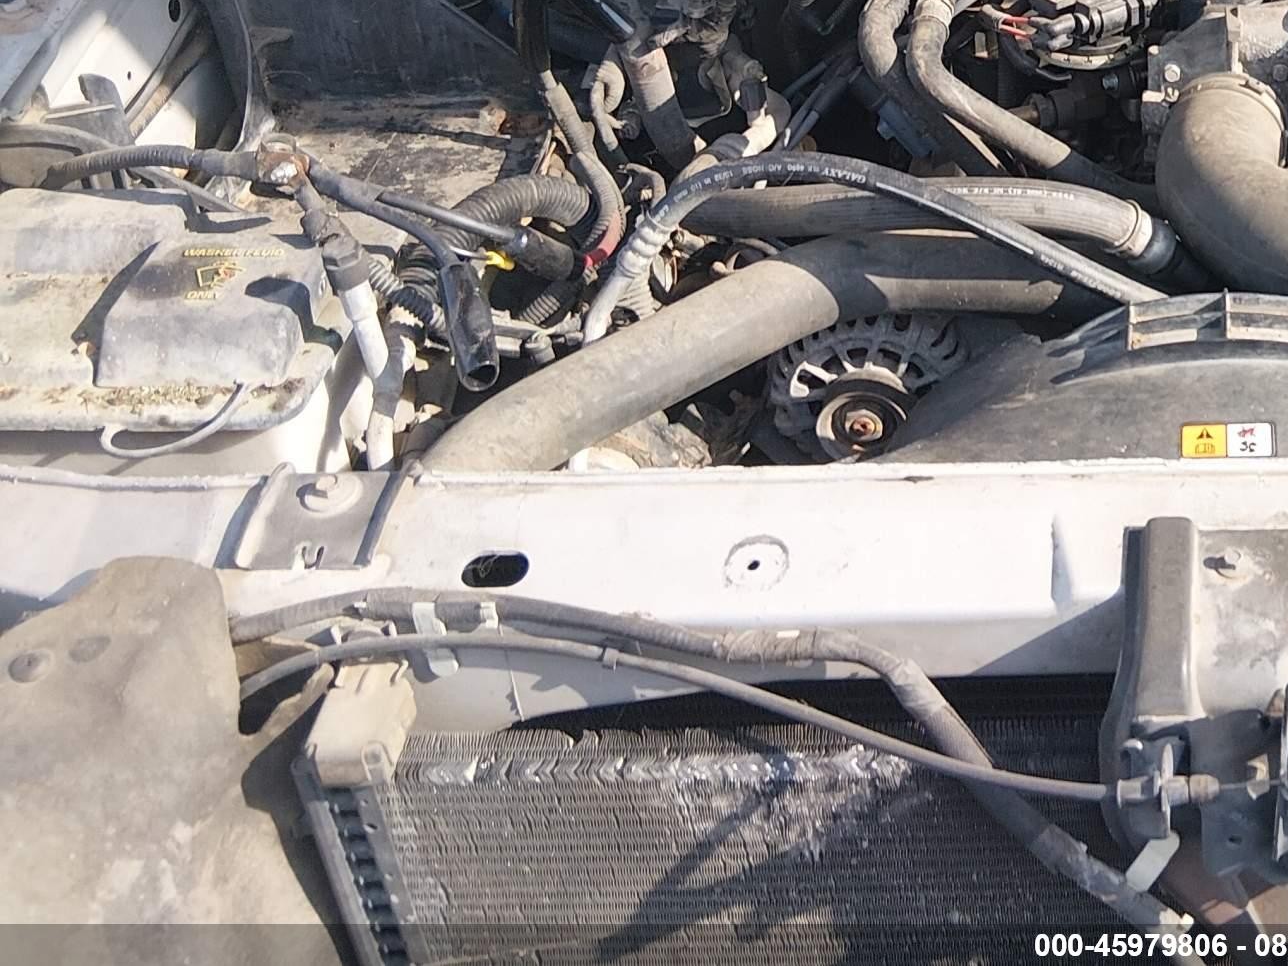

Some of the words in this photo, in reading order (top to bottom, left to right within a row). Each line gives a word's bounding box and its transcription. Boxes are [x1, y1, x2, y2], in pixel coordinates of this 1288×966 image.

[821, 166, 867, 184] GALAXY
[183, 248, 239, 258] WASHER
[243, 248, 285, 258] FLUID
